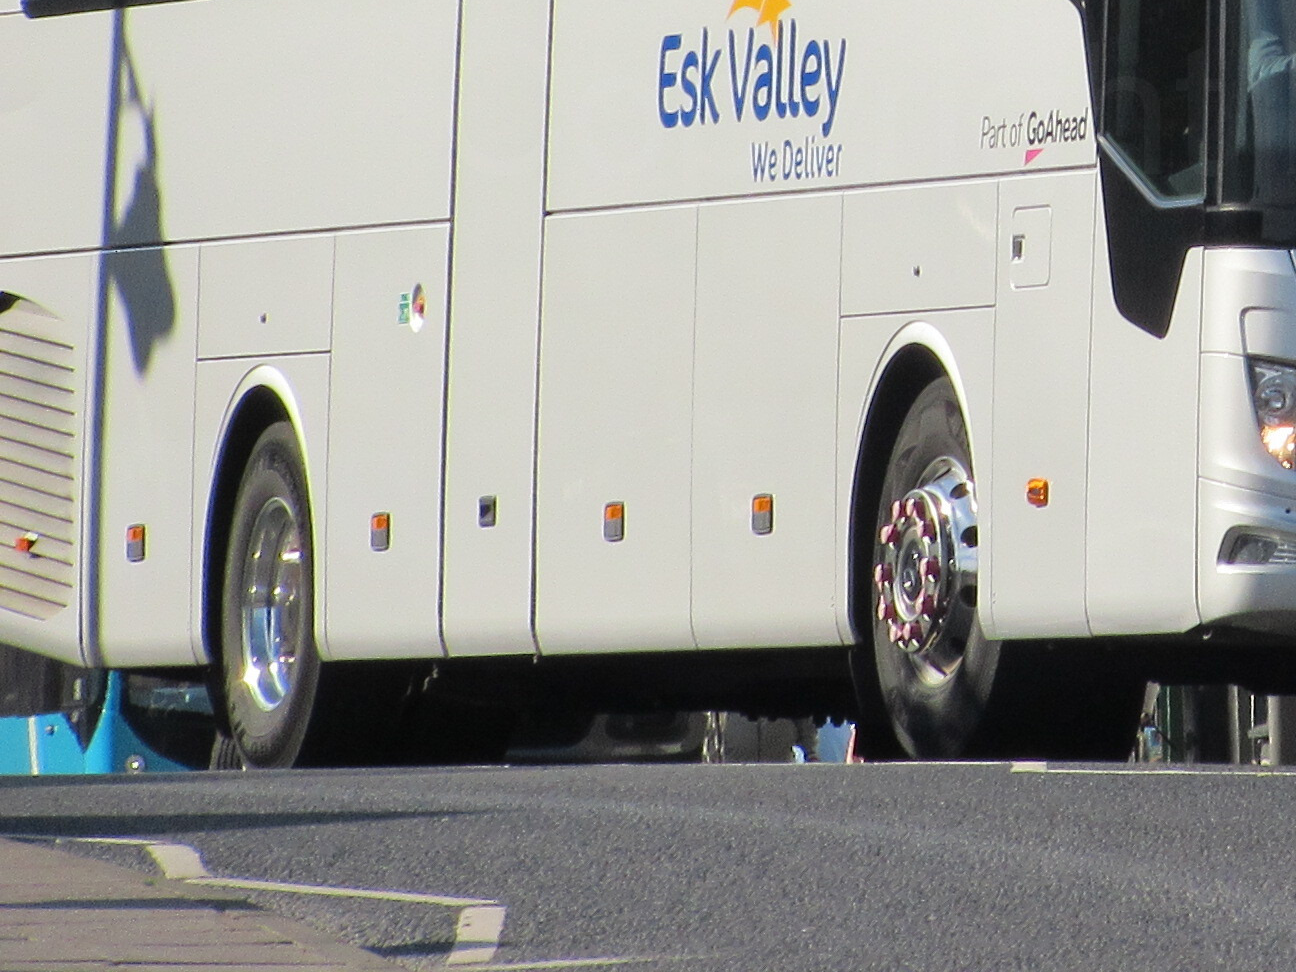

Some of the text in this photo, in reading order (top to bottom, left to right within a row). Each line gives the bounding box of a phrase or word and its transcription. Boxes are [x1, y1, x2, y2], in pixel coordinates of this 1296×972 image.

[658, 18, 846, 137] Esk Valley
[979, 107, 1088, 149] Part of GoAhead
[751, 138, 843, 182] We Deliver
